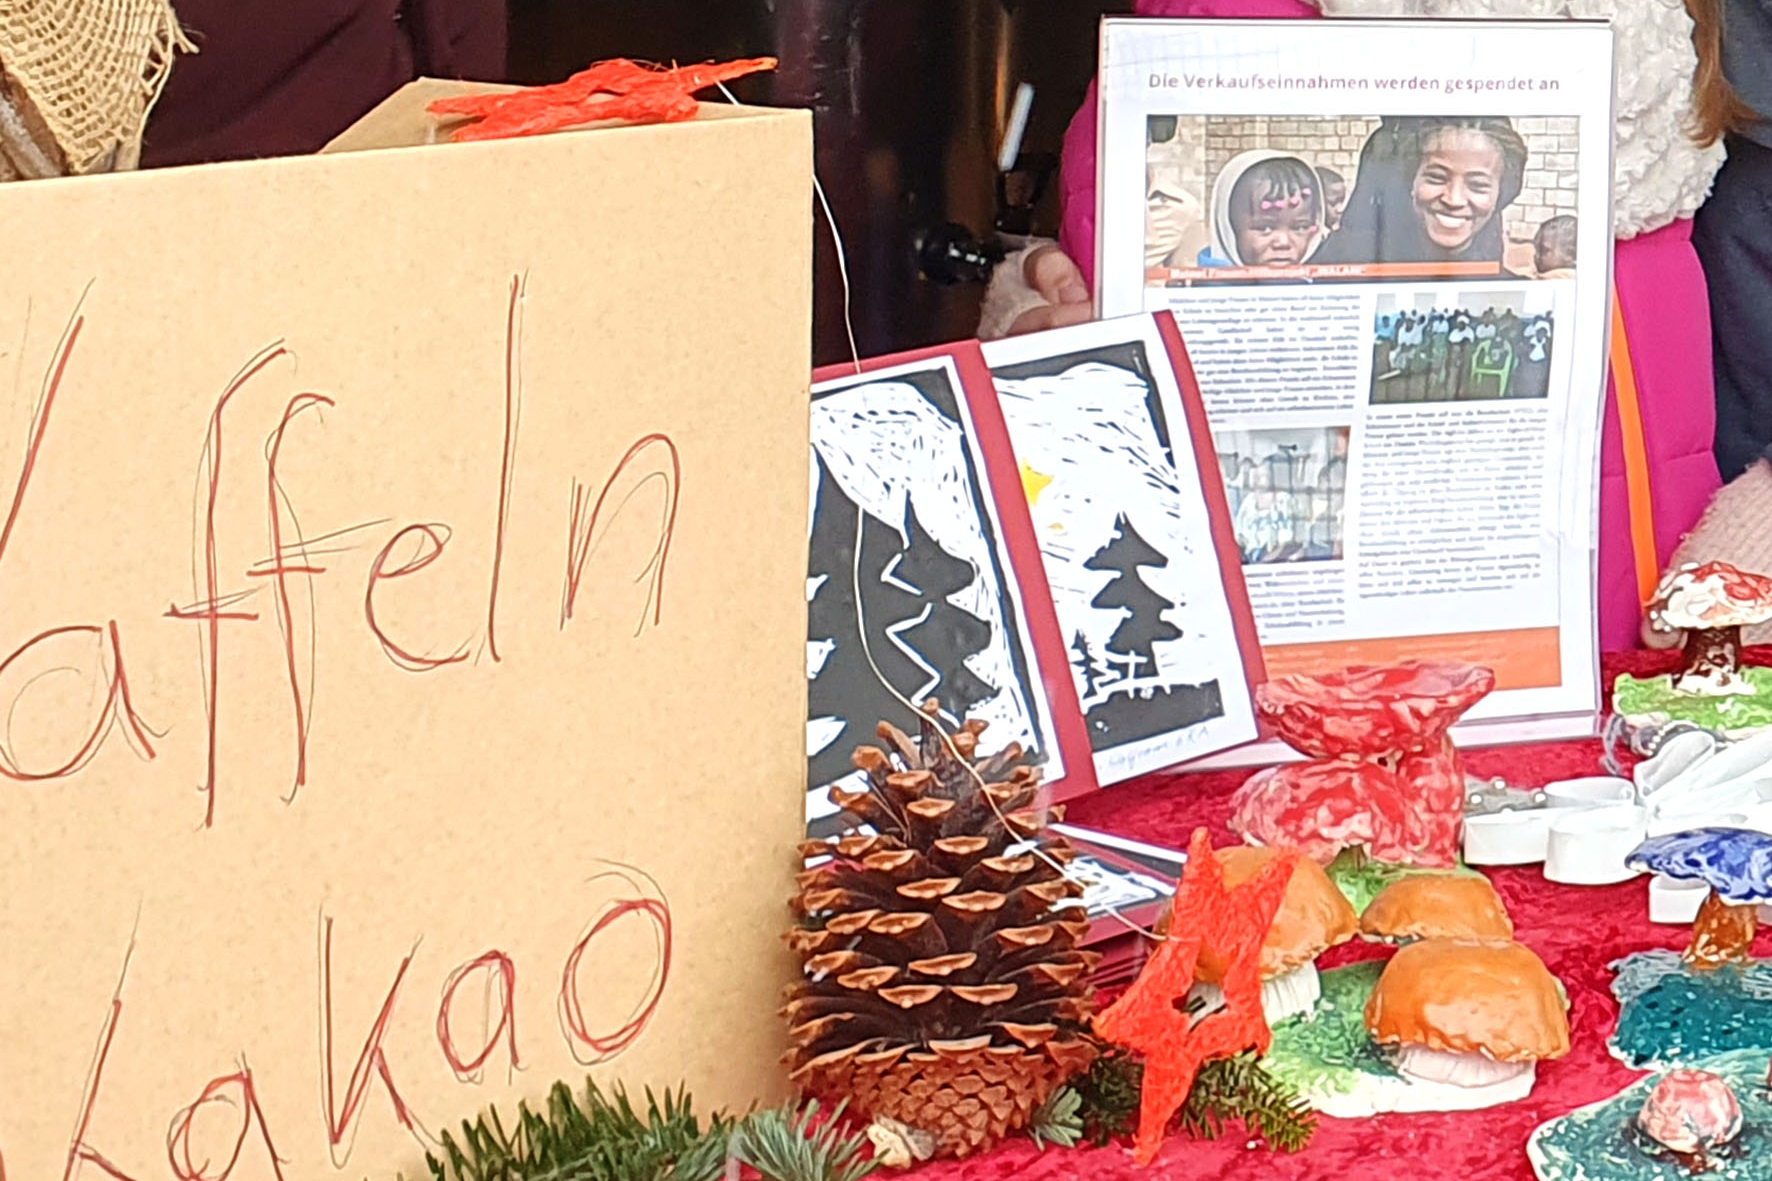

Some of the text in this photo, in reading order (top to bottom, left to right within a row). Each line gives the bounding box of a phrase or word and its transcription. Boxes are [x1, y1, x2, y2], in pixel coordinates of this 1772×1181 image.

[1149, 74, 1560, 93] Die Verkaufseinnahmen werden gespendet an
